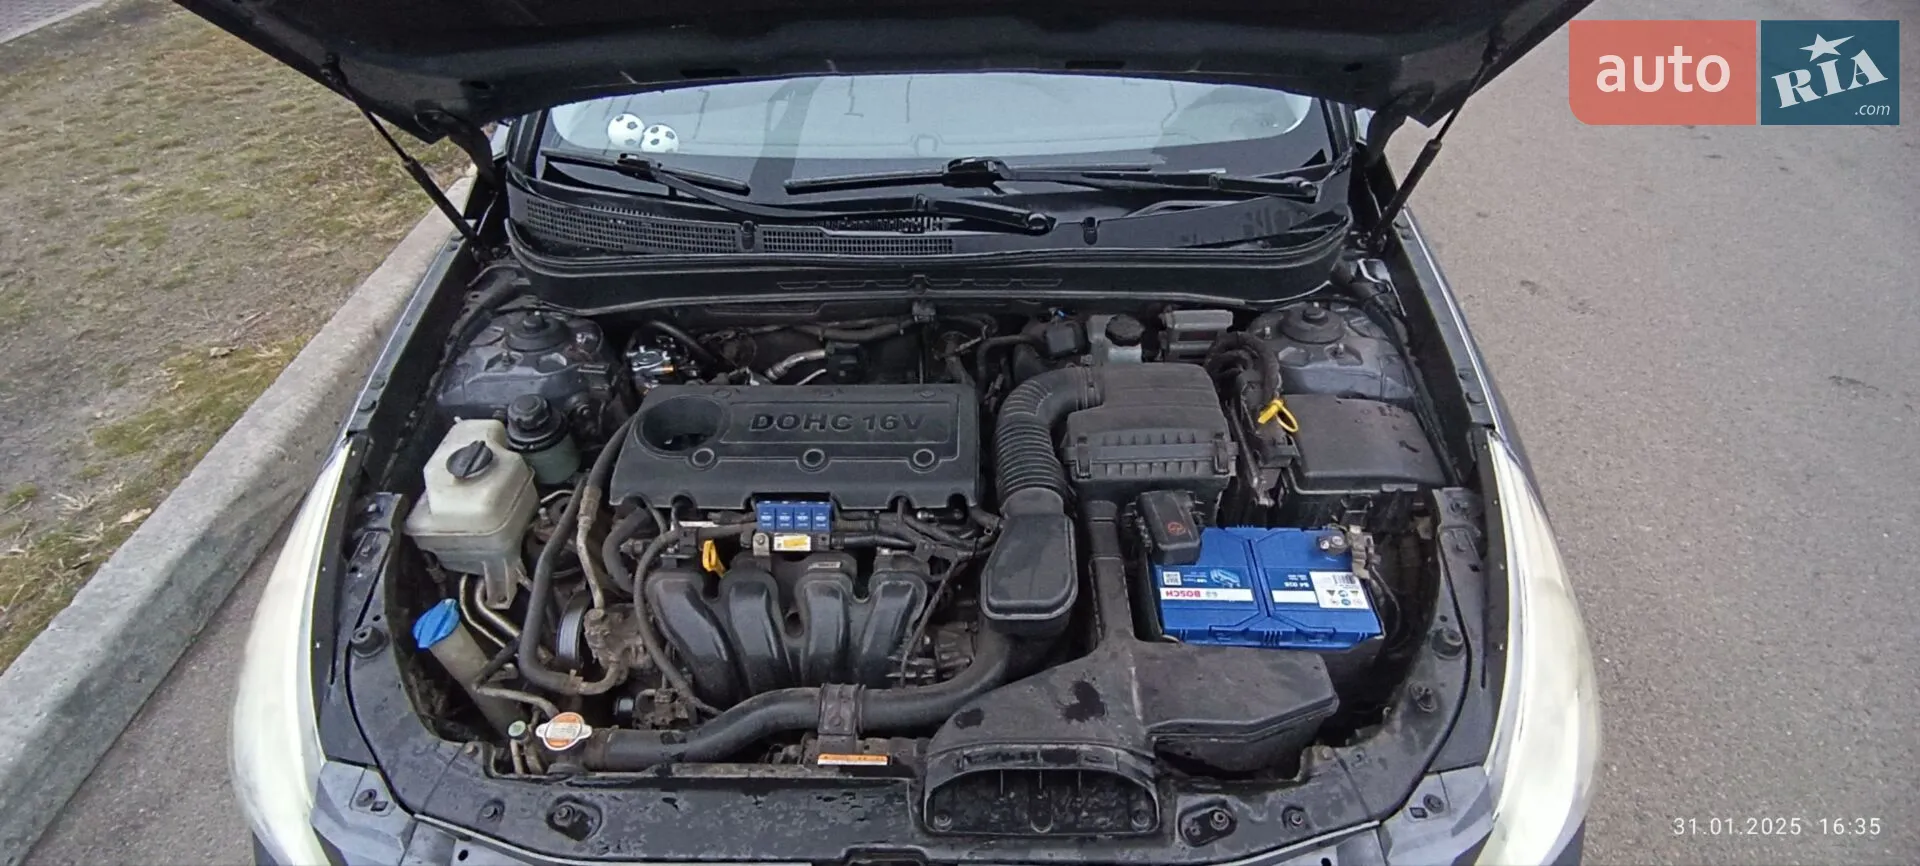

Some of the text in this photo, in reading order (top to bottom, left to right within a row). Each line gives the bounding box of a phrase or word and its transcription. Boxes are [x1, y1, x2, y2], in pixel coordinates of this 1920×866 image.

[750, 413, 926, 431] DOHC 16V
[1165, 590, 1201, 598] BOSCH
